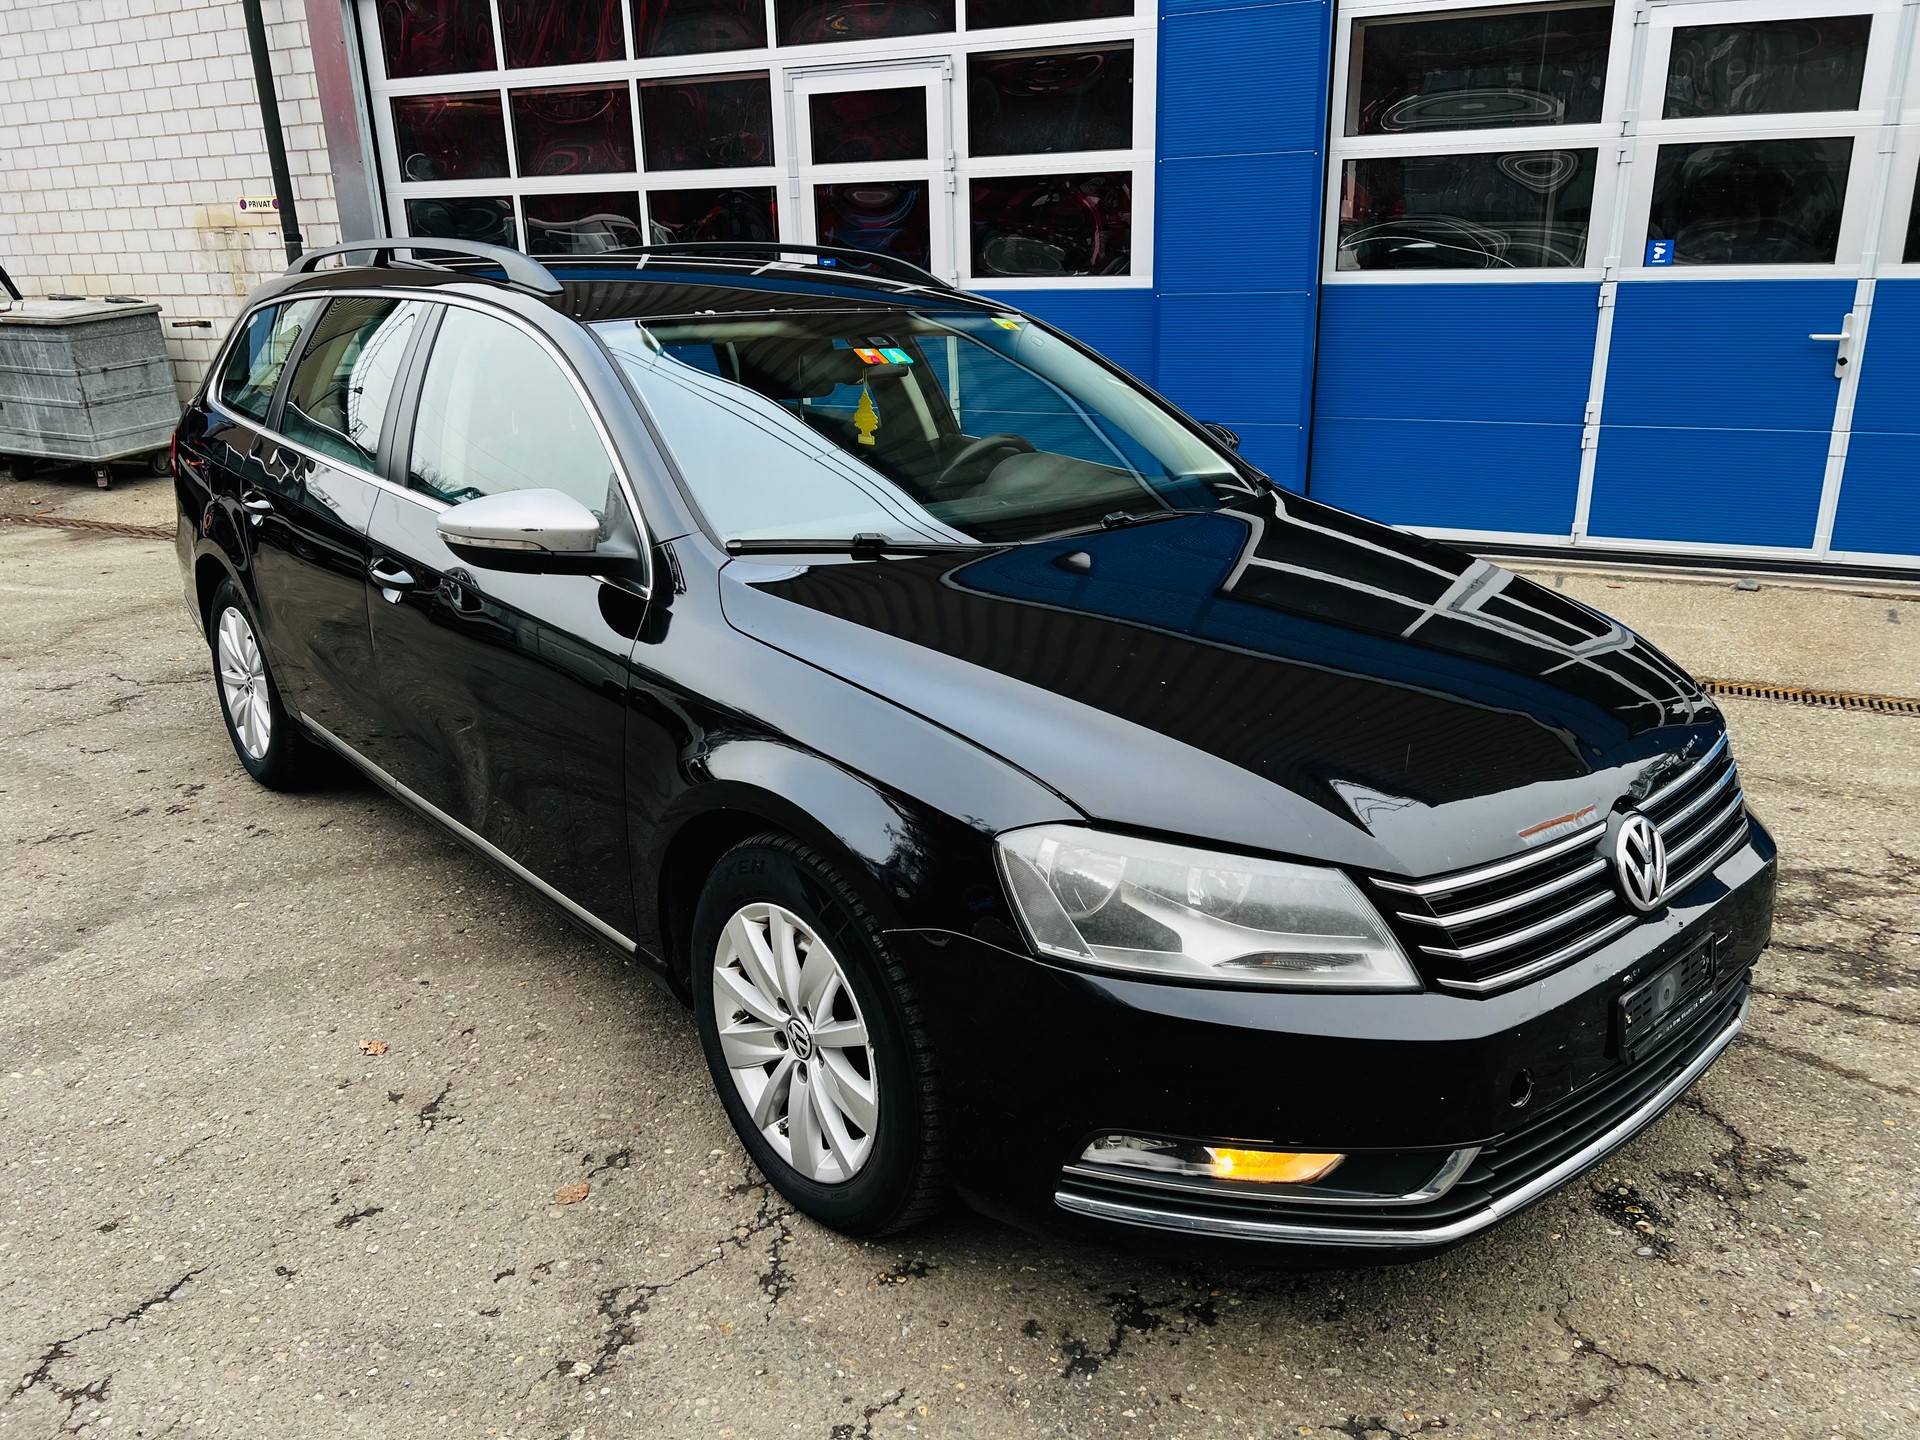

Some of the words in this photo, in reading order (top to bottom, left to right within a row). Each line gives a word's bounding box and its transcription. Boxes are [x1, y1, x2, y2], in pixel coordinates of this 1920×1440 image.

[248, 200, 271, 208] PRIVAT
[1616, 813, 1667, 912] VW
[787, 1019, 812, 1060] VW
